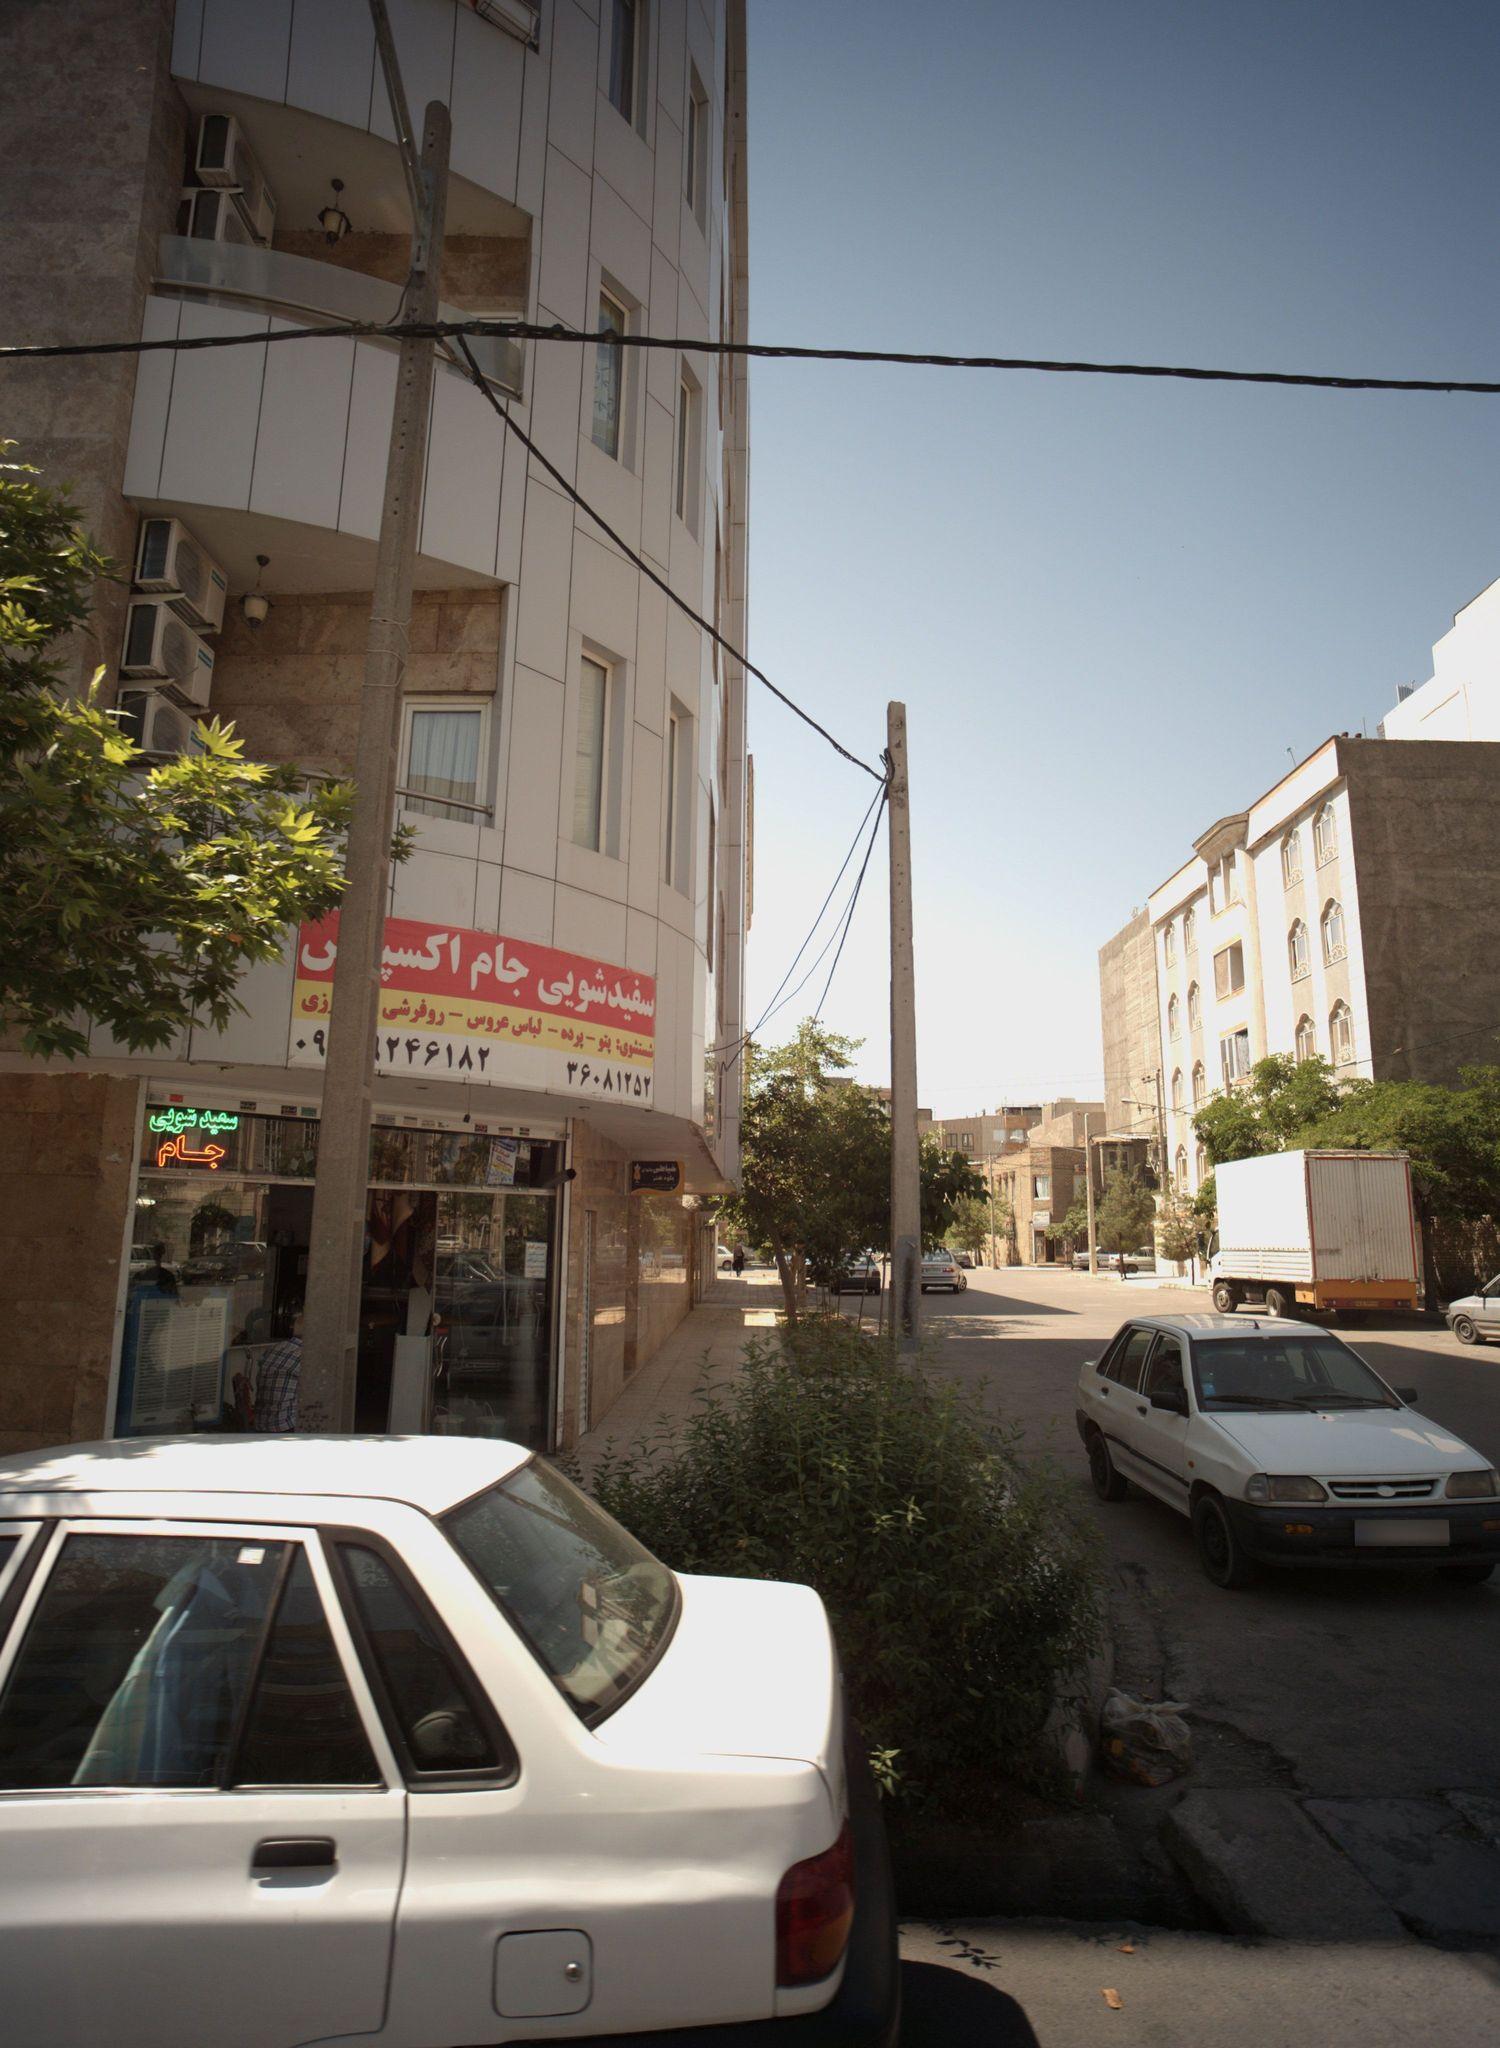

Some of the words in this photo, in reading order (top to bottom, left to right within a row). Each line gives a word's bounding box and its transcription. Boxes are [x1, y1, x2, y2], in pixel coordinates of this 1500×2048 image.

[470, 942, 529, 998] جام
[466, 1015, 509, 1033] عروس
[512, 1016, 542, 1039] لباس
[560, 1028, 584, 1049] پرده
[566, 1061, 651, 1097] ۳۶۰۸۱۲۵۲
[158, 1135, 226, 1169] جام
